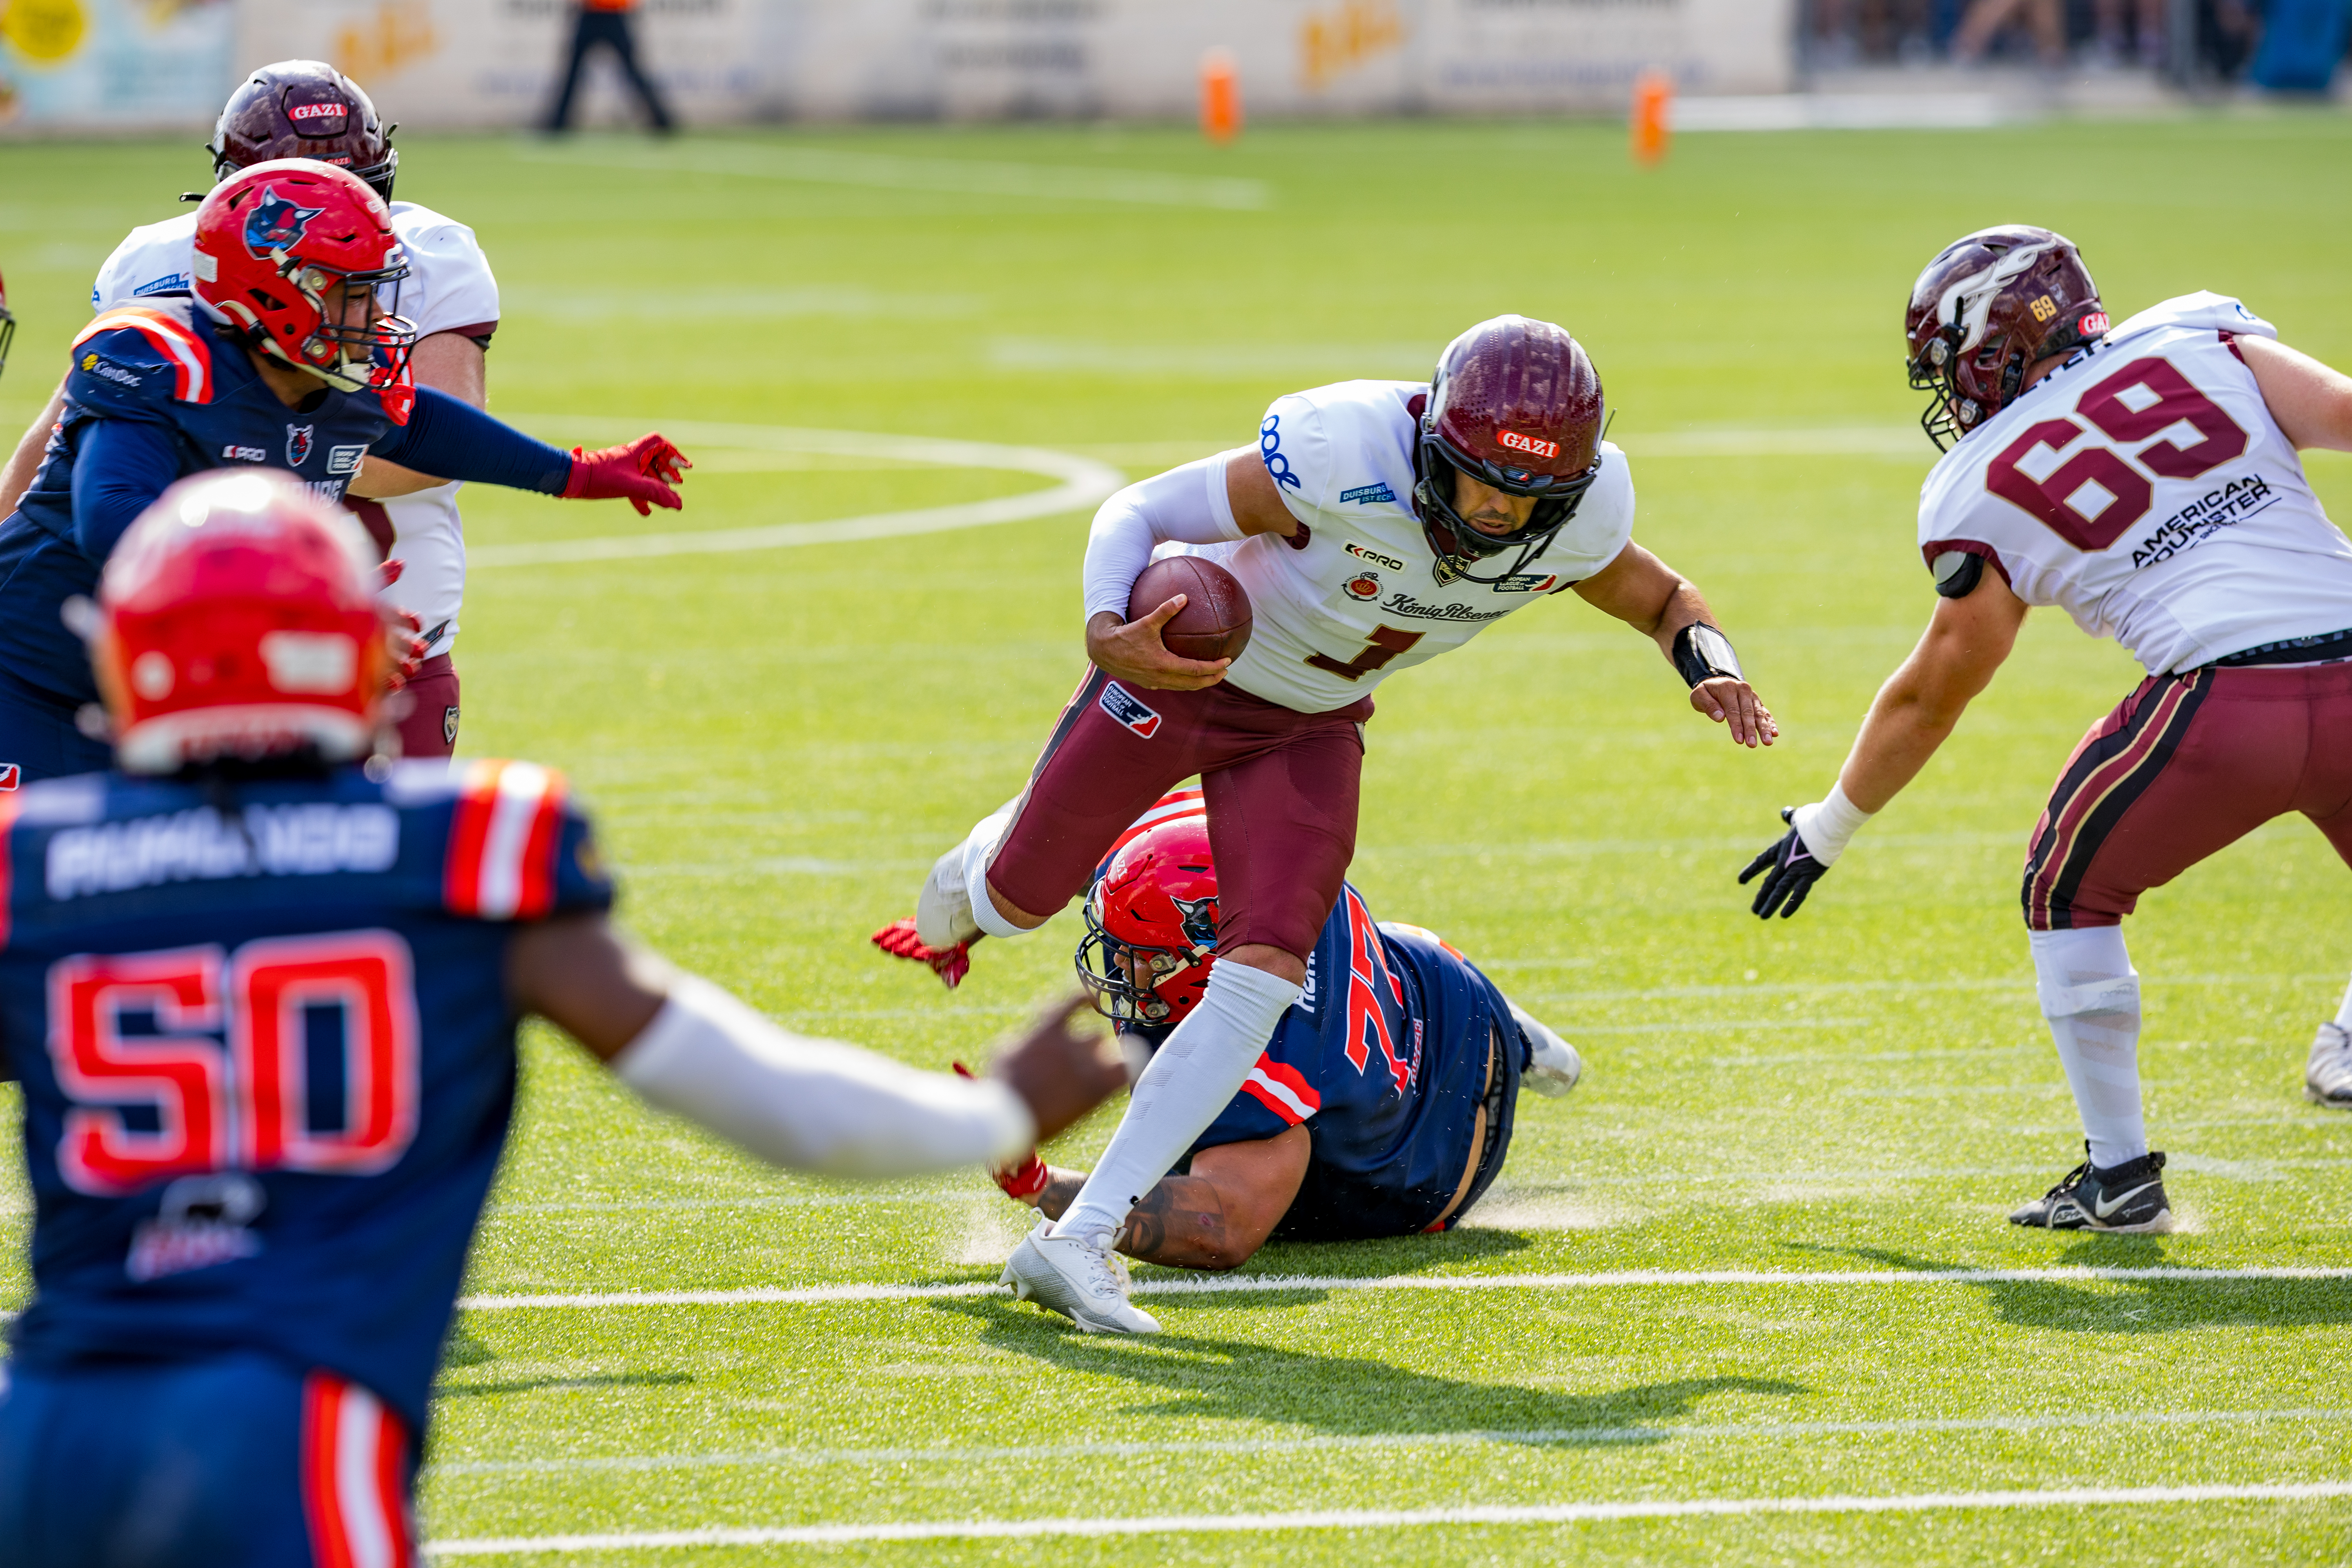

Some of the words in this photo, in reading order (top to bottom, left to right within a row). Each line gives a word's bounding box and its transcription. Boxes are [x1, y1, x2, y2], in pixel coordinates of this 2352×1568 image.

[2030, 294, 2057, 322] 69
[1984, 356, 2250, 553] 69
[1343, 485, 1386, 500] DUISBURG
[2132, 474, 2263, 569] AMERICAN
[1383, 593, 1444, 619] König
[1439, 603, 1510, 620] Pilsener
[1105, 690, 1122, 707] LEAGUE
[1109, 685, 1132, 708] EUROPEAN
[46, 929, 422, 1196] 50
